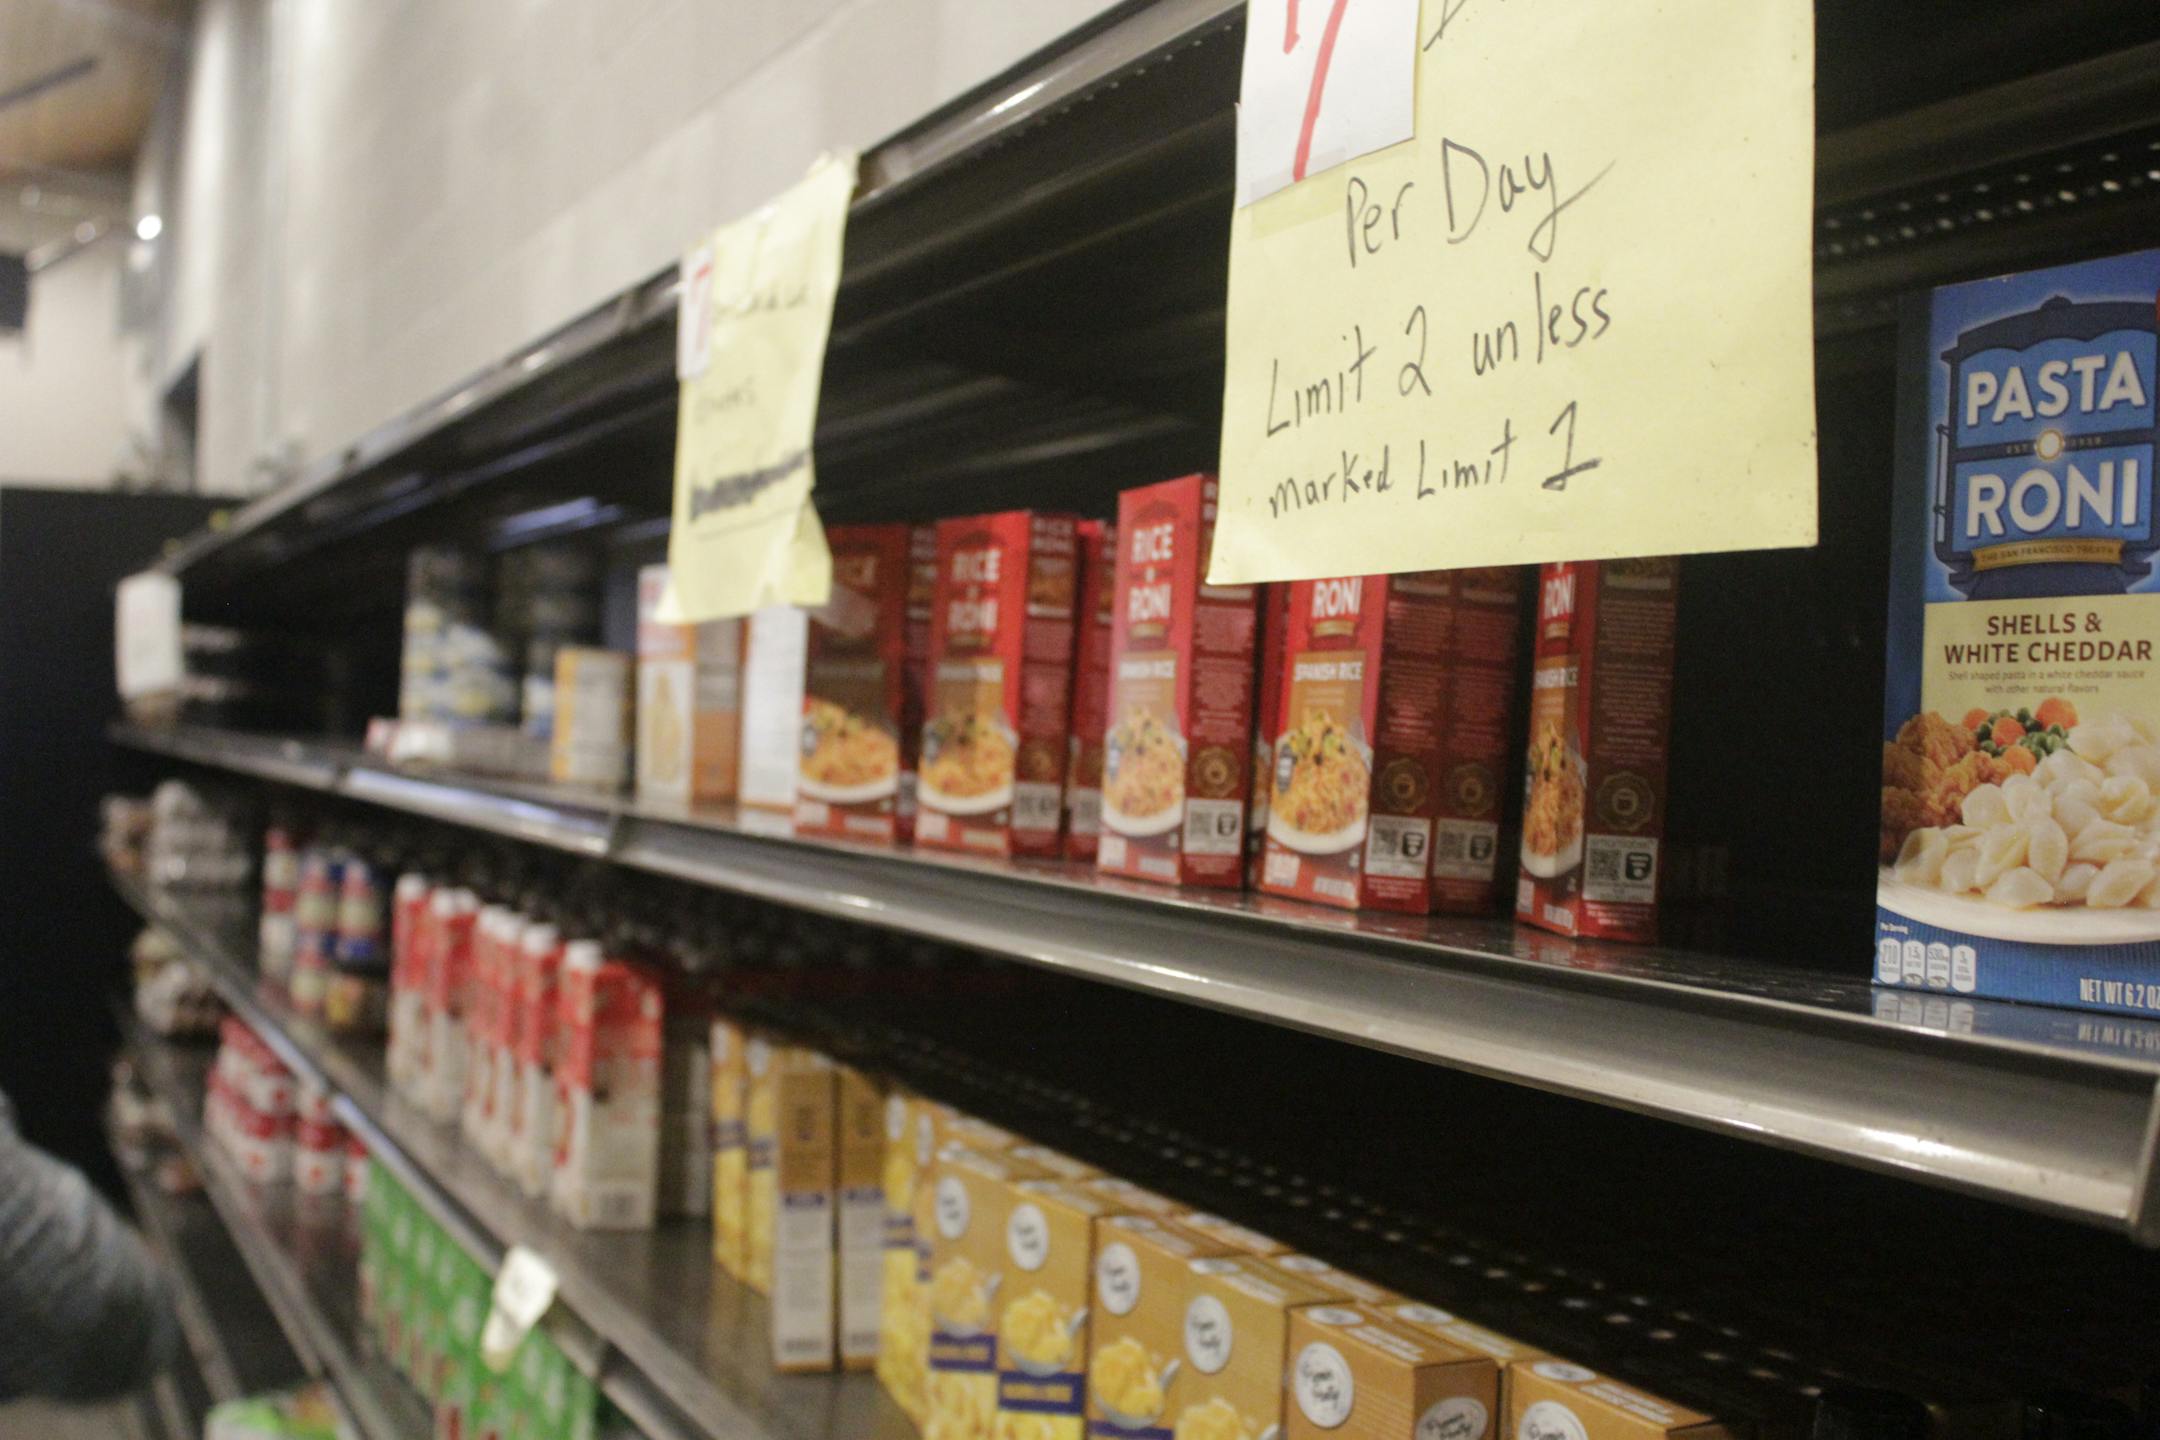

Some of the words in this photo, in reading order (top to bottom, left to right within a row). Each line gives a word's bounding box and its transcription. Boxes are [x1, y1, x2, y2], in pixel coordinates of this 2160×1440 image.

[1347, 176, 1415, 267] Per
[1443, 137, 1616, 263] Day
[1266, 326, 1377, 437] Limit
[1400, 305, 1432, 397] 2
[1473, 272, 1611, 376] unless
[1966, 350, 2146, 427] PASTA
[1270, 444, 1393, 519] marked
[1416, 419, 1518, 500] Limit
[1542, 401, 1602, 490] 1
[1966, 459, 2138, 537] RONI
[1131, 523, 1174, 564] RICE
[954, 548, 1000, 581] RICE
[1128, 583, 1171, 623] RONI
[1313, 576, 1362, 618] RONI
[1544, 573, 1576, 619] RONI
[1987, 613, 2076, 636] SHELLS
[2085, 612, 2102, 633] &
[1294, 663, 1336, 681] SPANISH
[1339, 661, 1363, 680] RICE
[1944, 643, 2020, 664] WHITE
[2028, 640, 2153, 662] CHEDDAR
[2002, 671, 2026, 682] pasta
[2075, 670, 2113, 680] cheddar
[2117, 671, 2145, 679] sauce
[2034, 684, 2064, 694] natural
[2067, 684, 2099, 694] flavors
[2080, 978, 2101, 1002] NET
[2103, 981, 2123, 1006] WT
[2125, 983, 2145, 1008] 6.2
